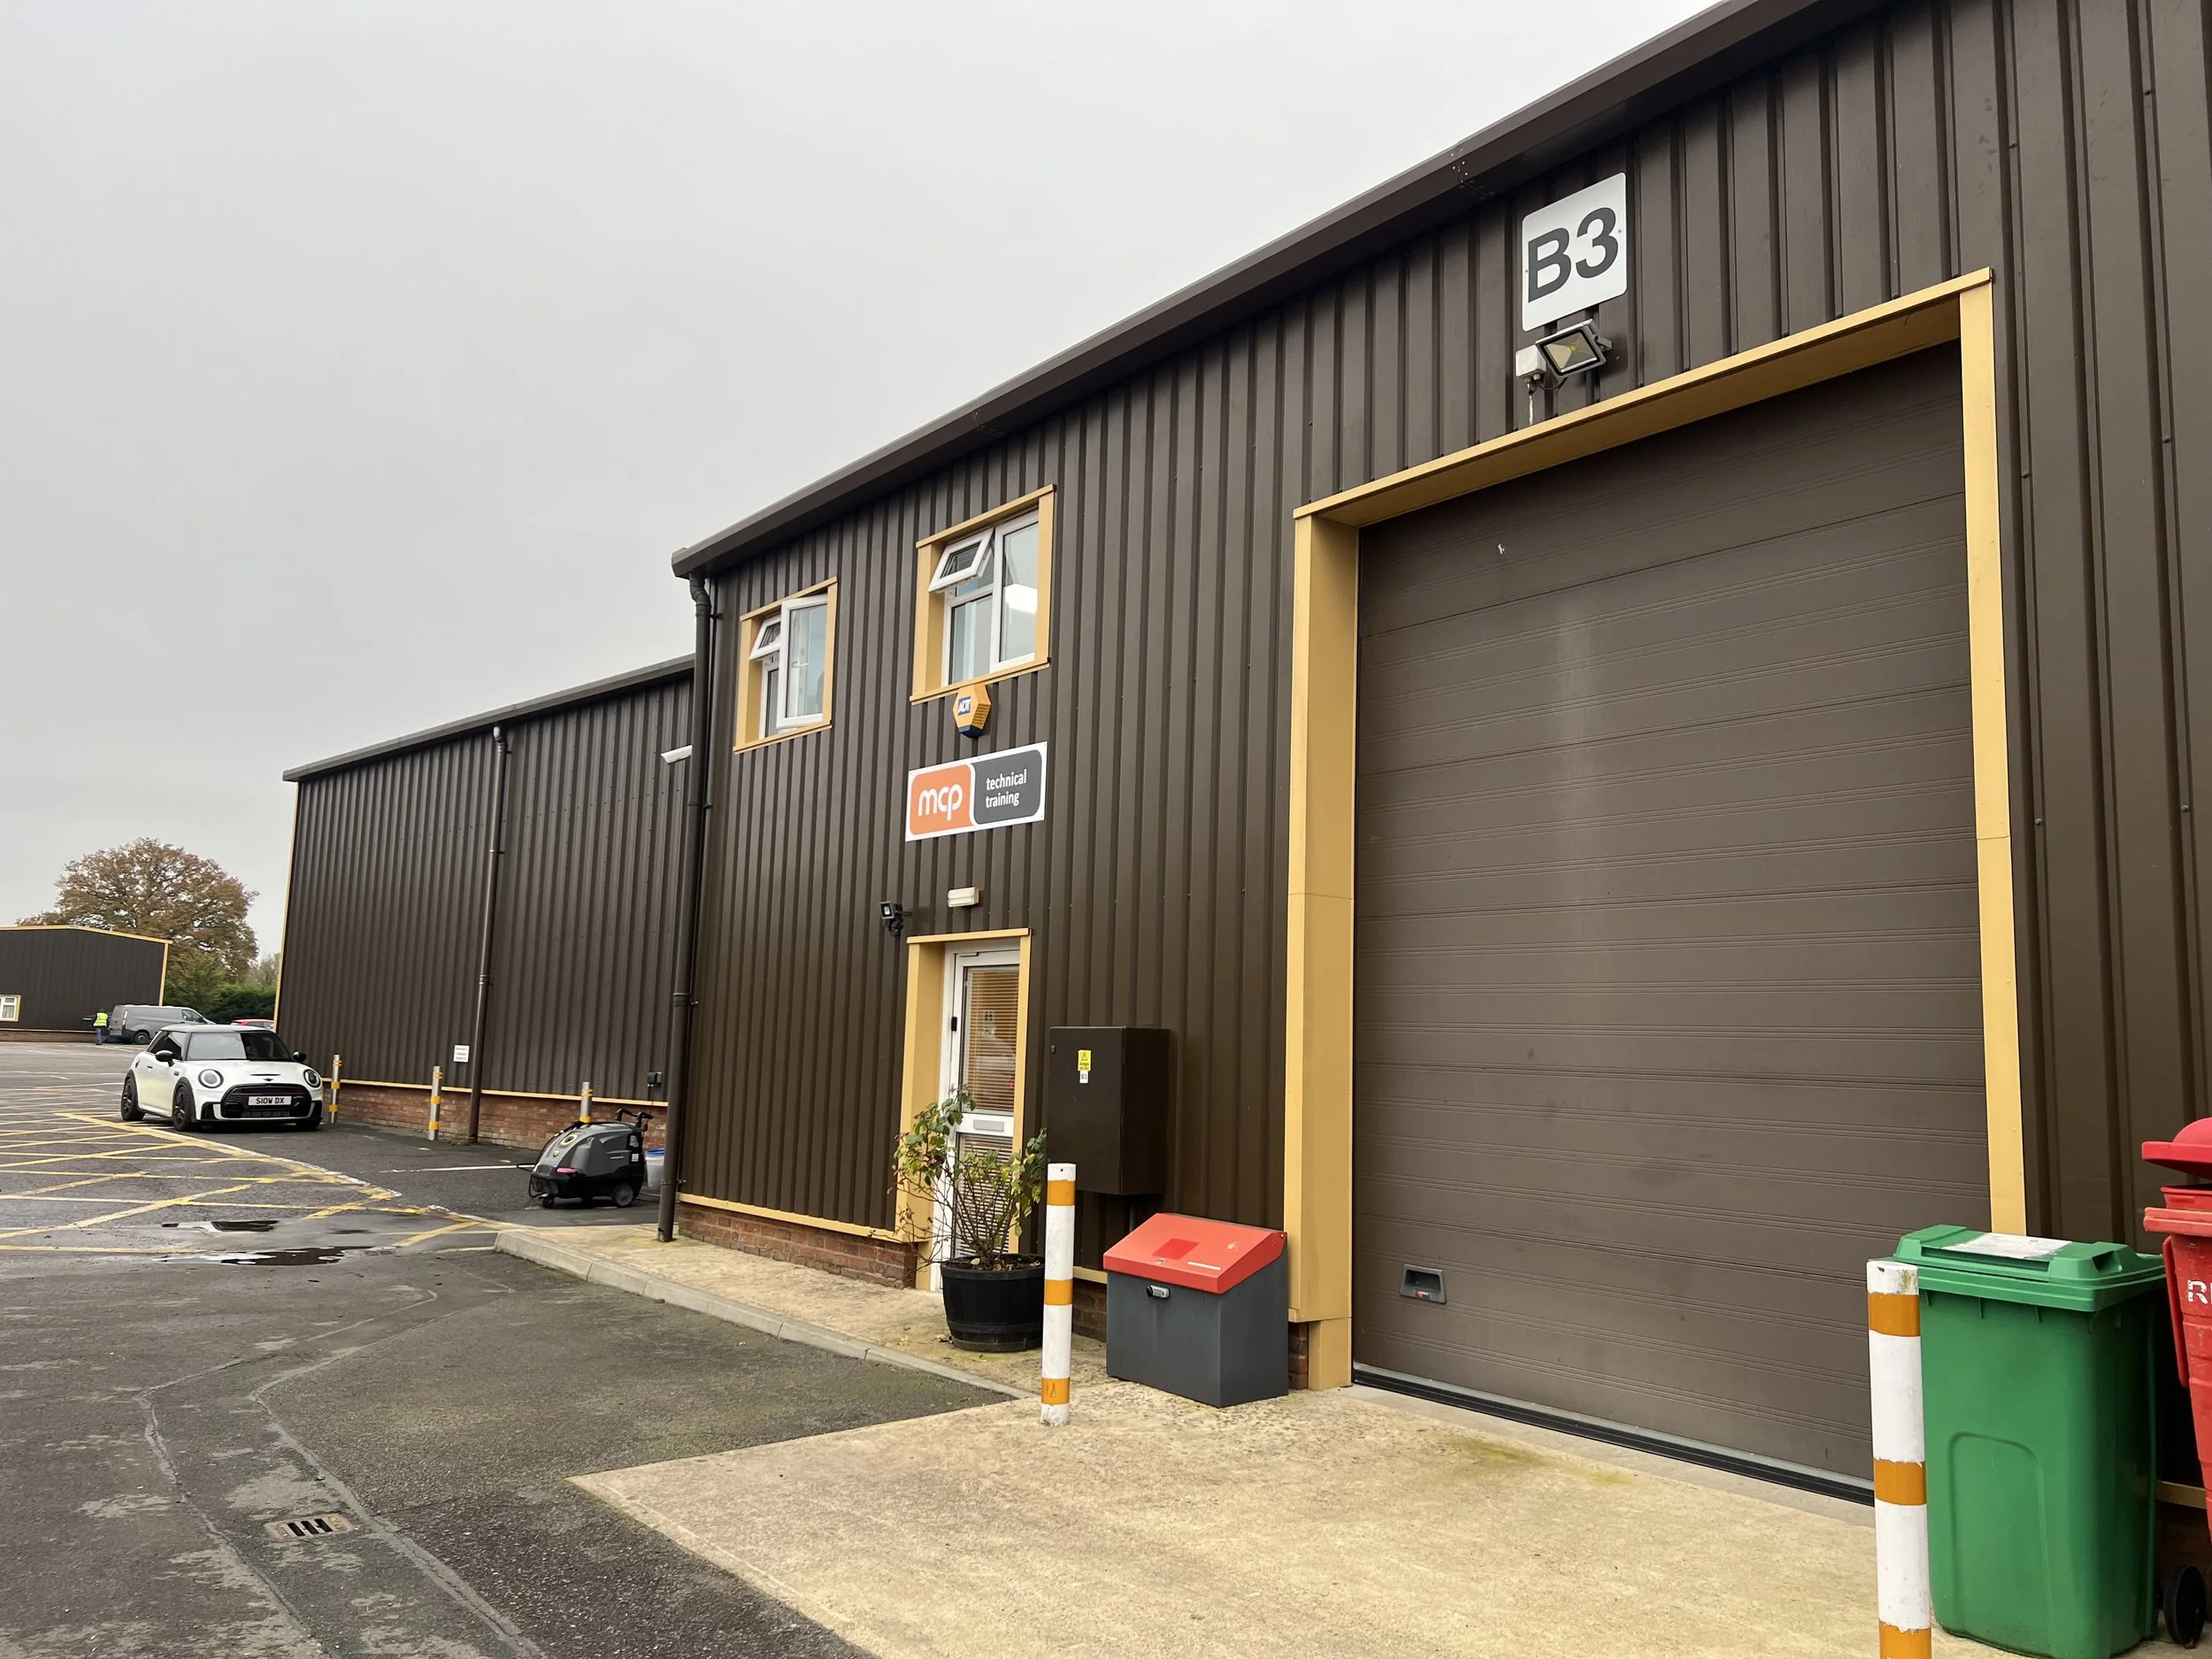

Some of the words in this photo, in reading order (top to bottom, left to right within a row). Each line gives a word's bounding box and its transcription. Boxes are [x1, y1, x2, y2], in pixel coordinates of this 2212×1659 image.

[1528, 207, 1618, 303] B3
[958, 698, 971, 714] ADT
[986, 768, 1026, 791] technical
[918, 783, 963, 821] mcp
[985, 791, 1019, 808] training
